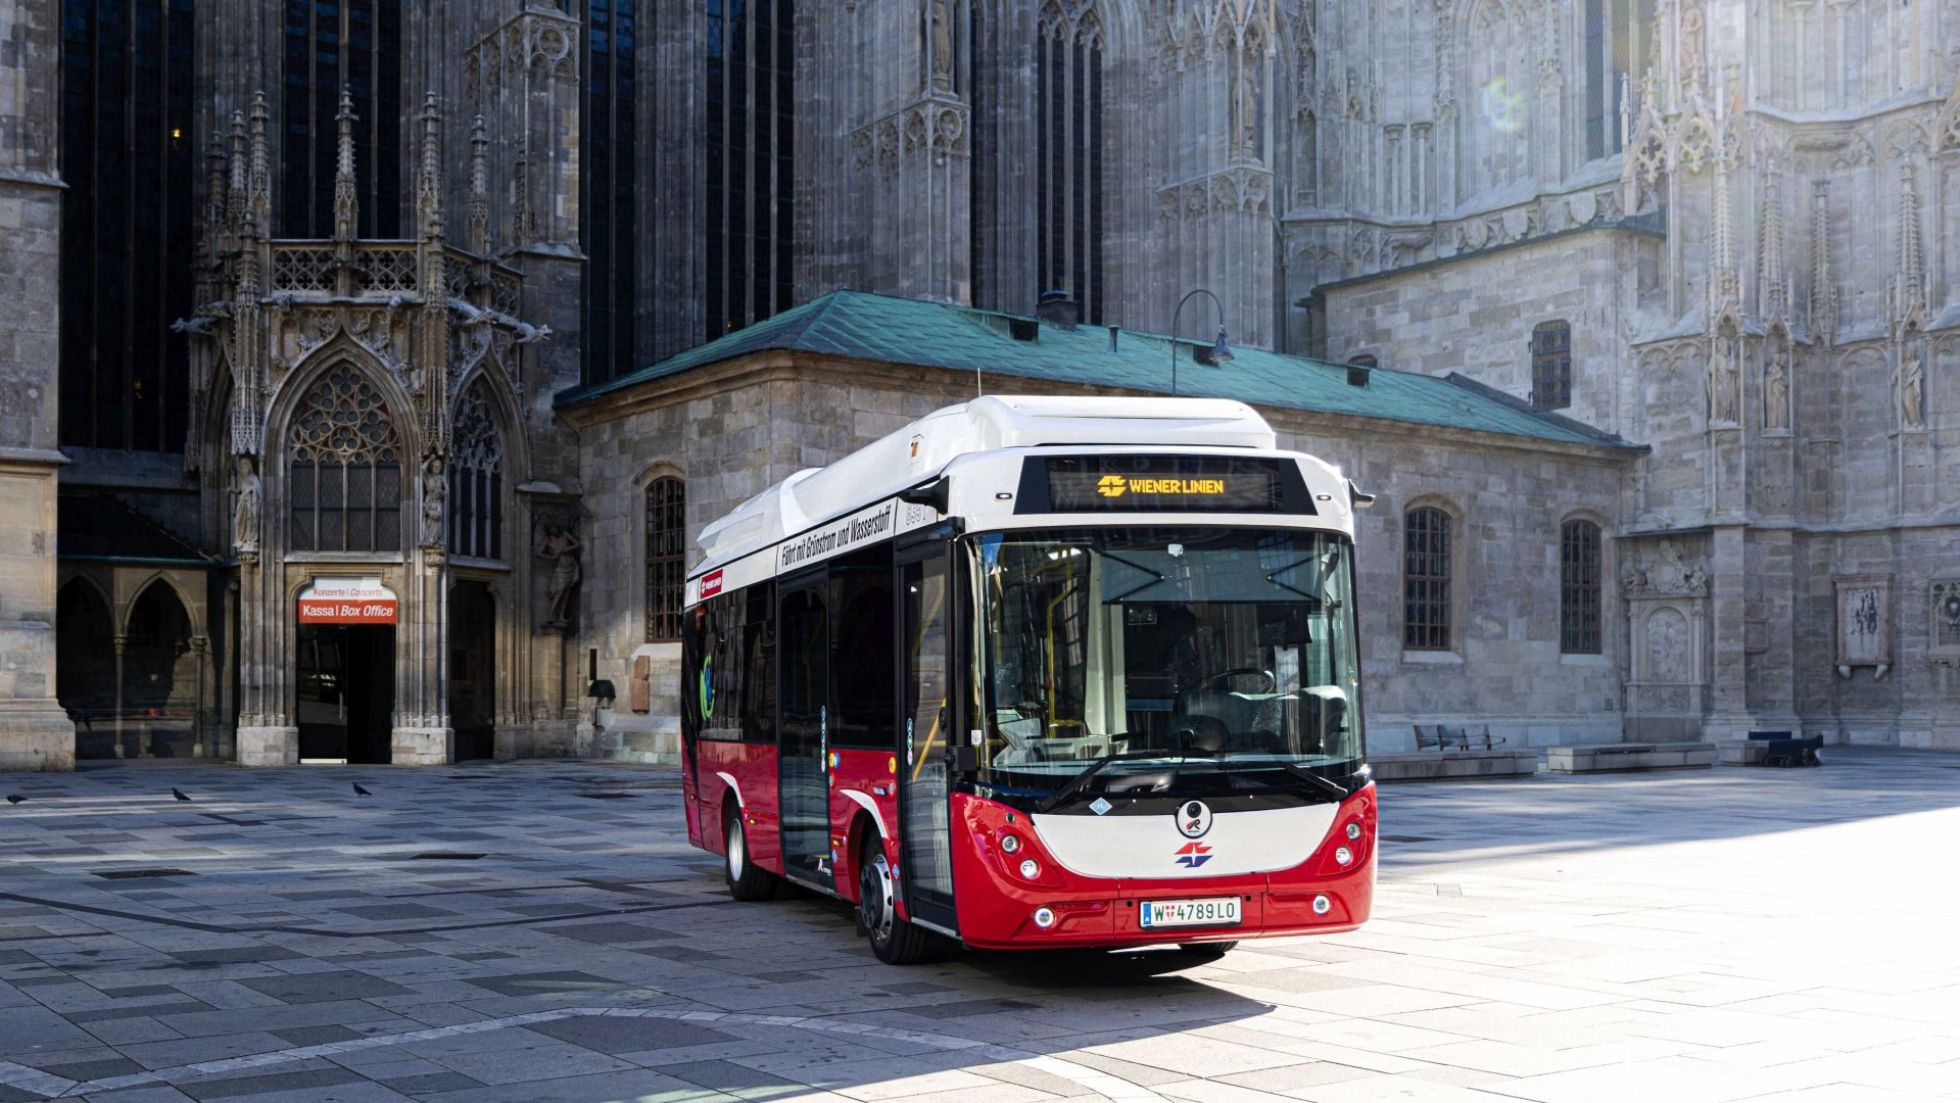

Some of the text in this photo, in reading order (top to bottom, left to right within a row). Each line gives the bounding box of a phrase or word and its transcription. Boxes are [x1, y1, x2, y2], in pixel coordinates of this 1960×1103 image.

[1129, 479, 1224, 494] WIENER LINIEN
[781, 504, 892, 567] Fährt mit Grünstrom und Wasserstoff
[303, 605, 334, 617] Kassa
[341, 605, 361, 617] Box
[363, 605, 394, 617] Office
